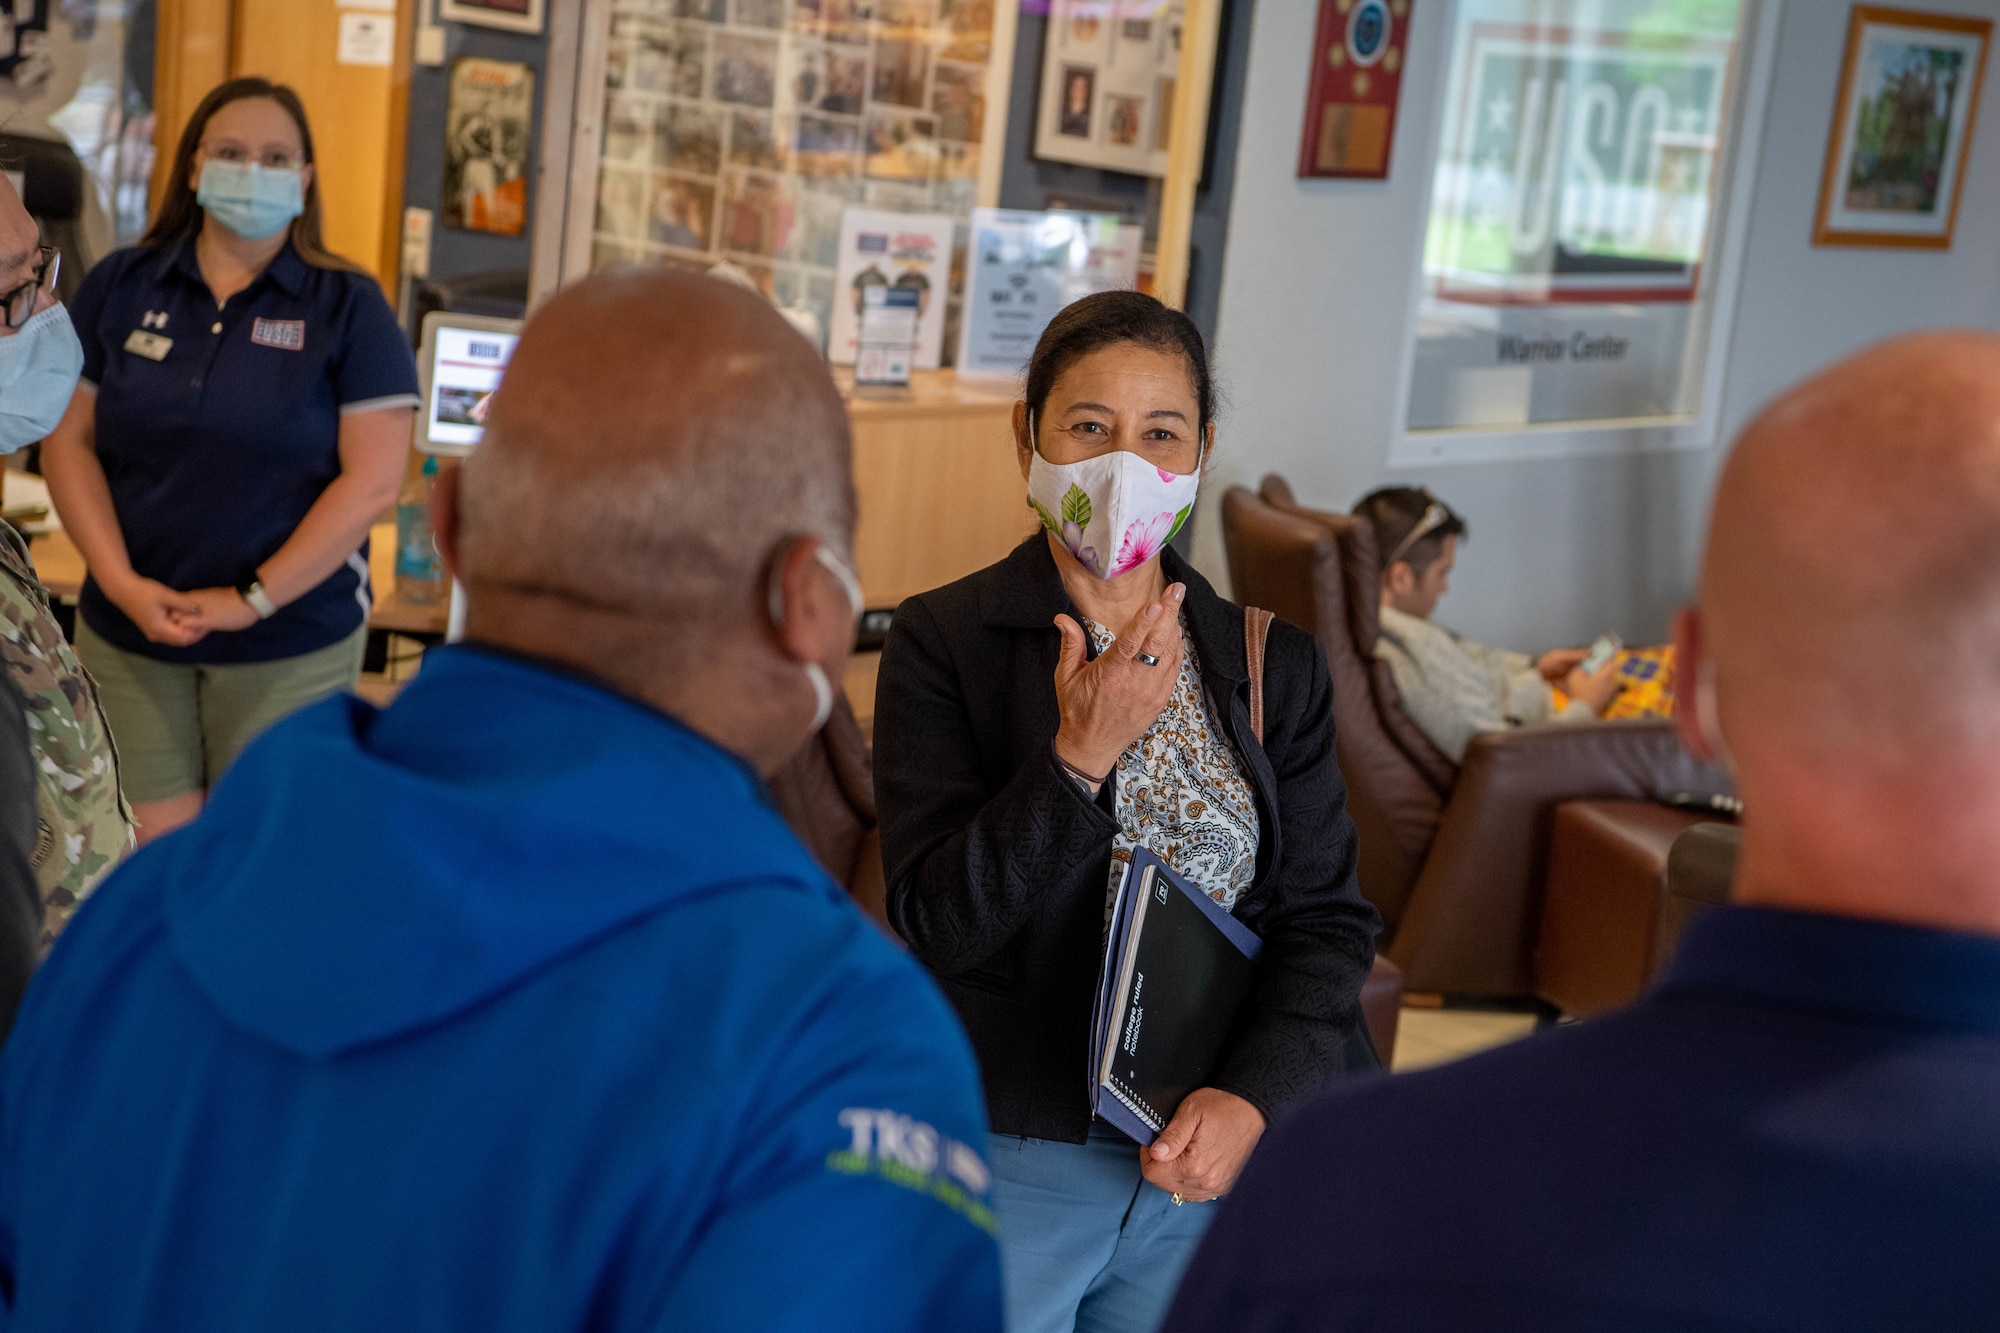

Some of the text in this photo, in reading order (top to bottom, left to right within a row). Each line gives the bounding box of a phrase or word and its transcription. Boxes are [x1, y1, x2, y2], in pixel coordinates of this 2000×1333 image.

[1498, 330, 1629, 363] Warrior Center
[1123, 971, 1144, 1051] college ruled
[1129, 1006, 1144, 1057] notebook
